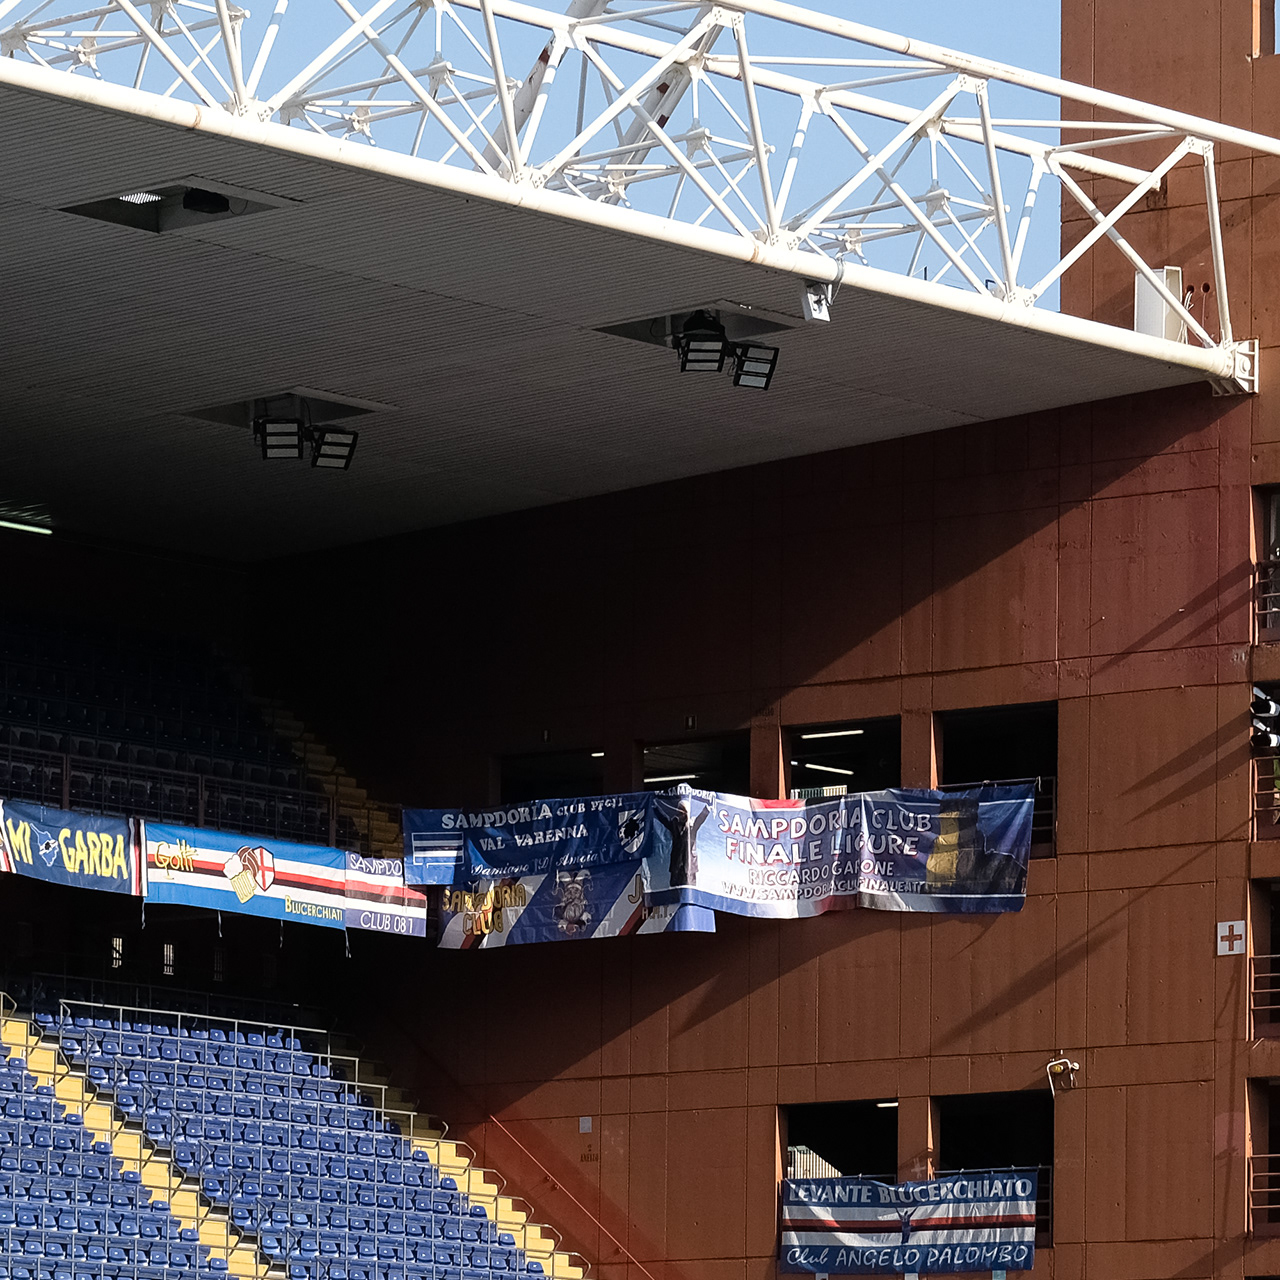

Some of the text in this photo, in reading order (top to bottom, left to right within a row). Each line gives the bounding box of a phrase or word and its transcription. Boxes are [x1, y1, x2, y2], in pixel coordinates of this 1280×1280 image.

[441, 803, 553, 830] SAMPDORIA
[717, 806, 932, 842] SAMPDORIA CLUB
[5, 817, 129, 880] MI GARBA
[479, 823, 589, 852] VAL VARENNA
[725, 831, 920, 866] FINALE LIGURE
[748, 864, 829, 886] RICCARDO
[360, 911, 413, 935] CLUB 081
[789, 1183, 873, 1203] LEVANTE
[786, 1244, 1028, 1267] Club ANGELO PALOMBO
